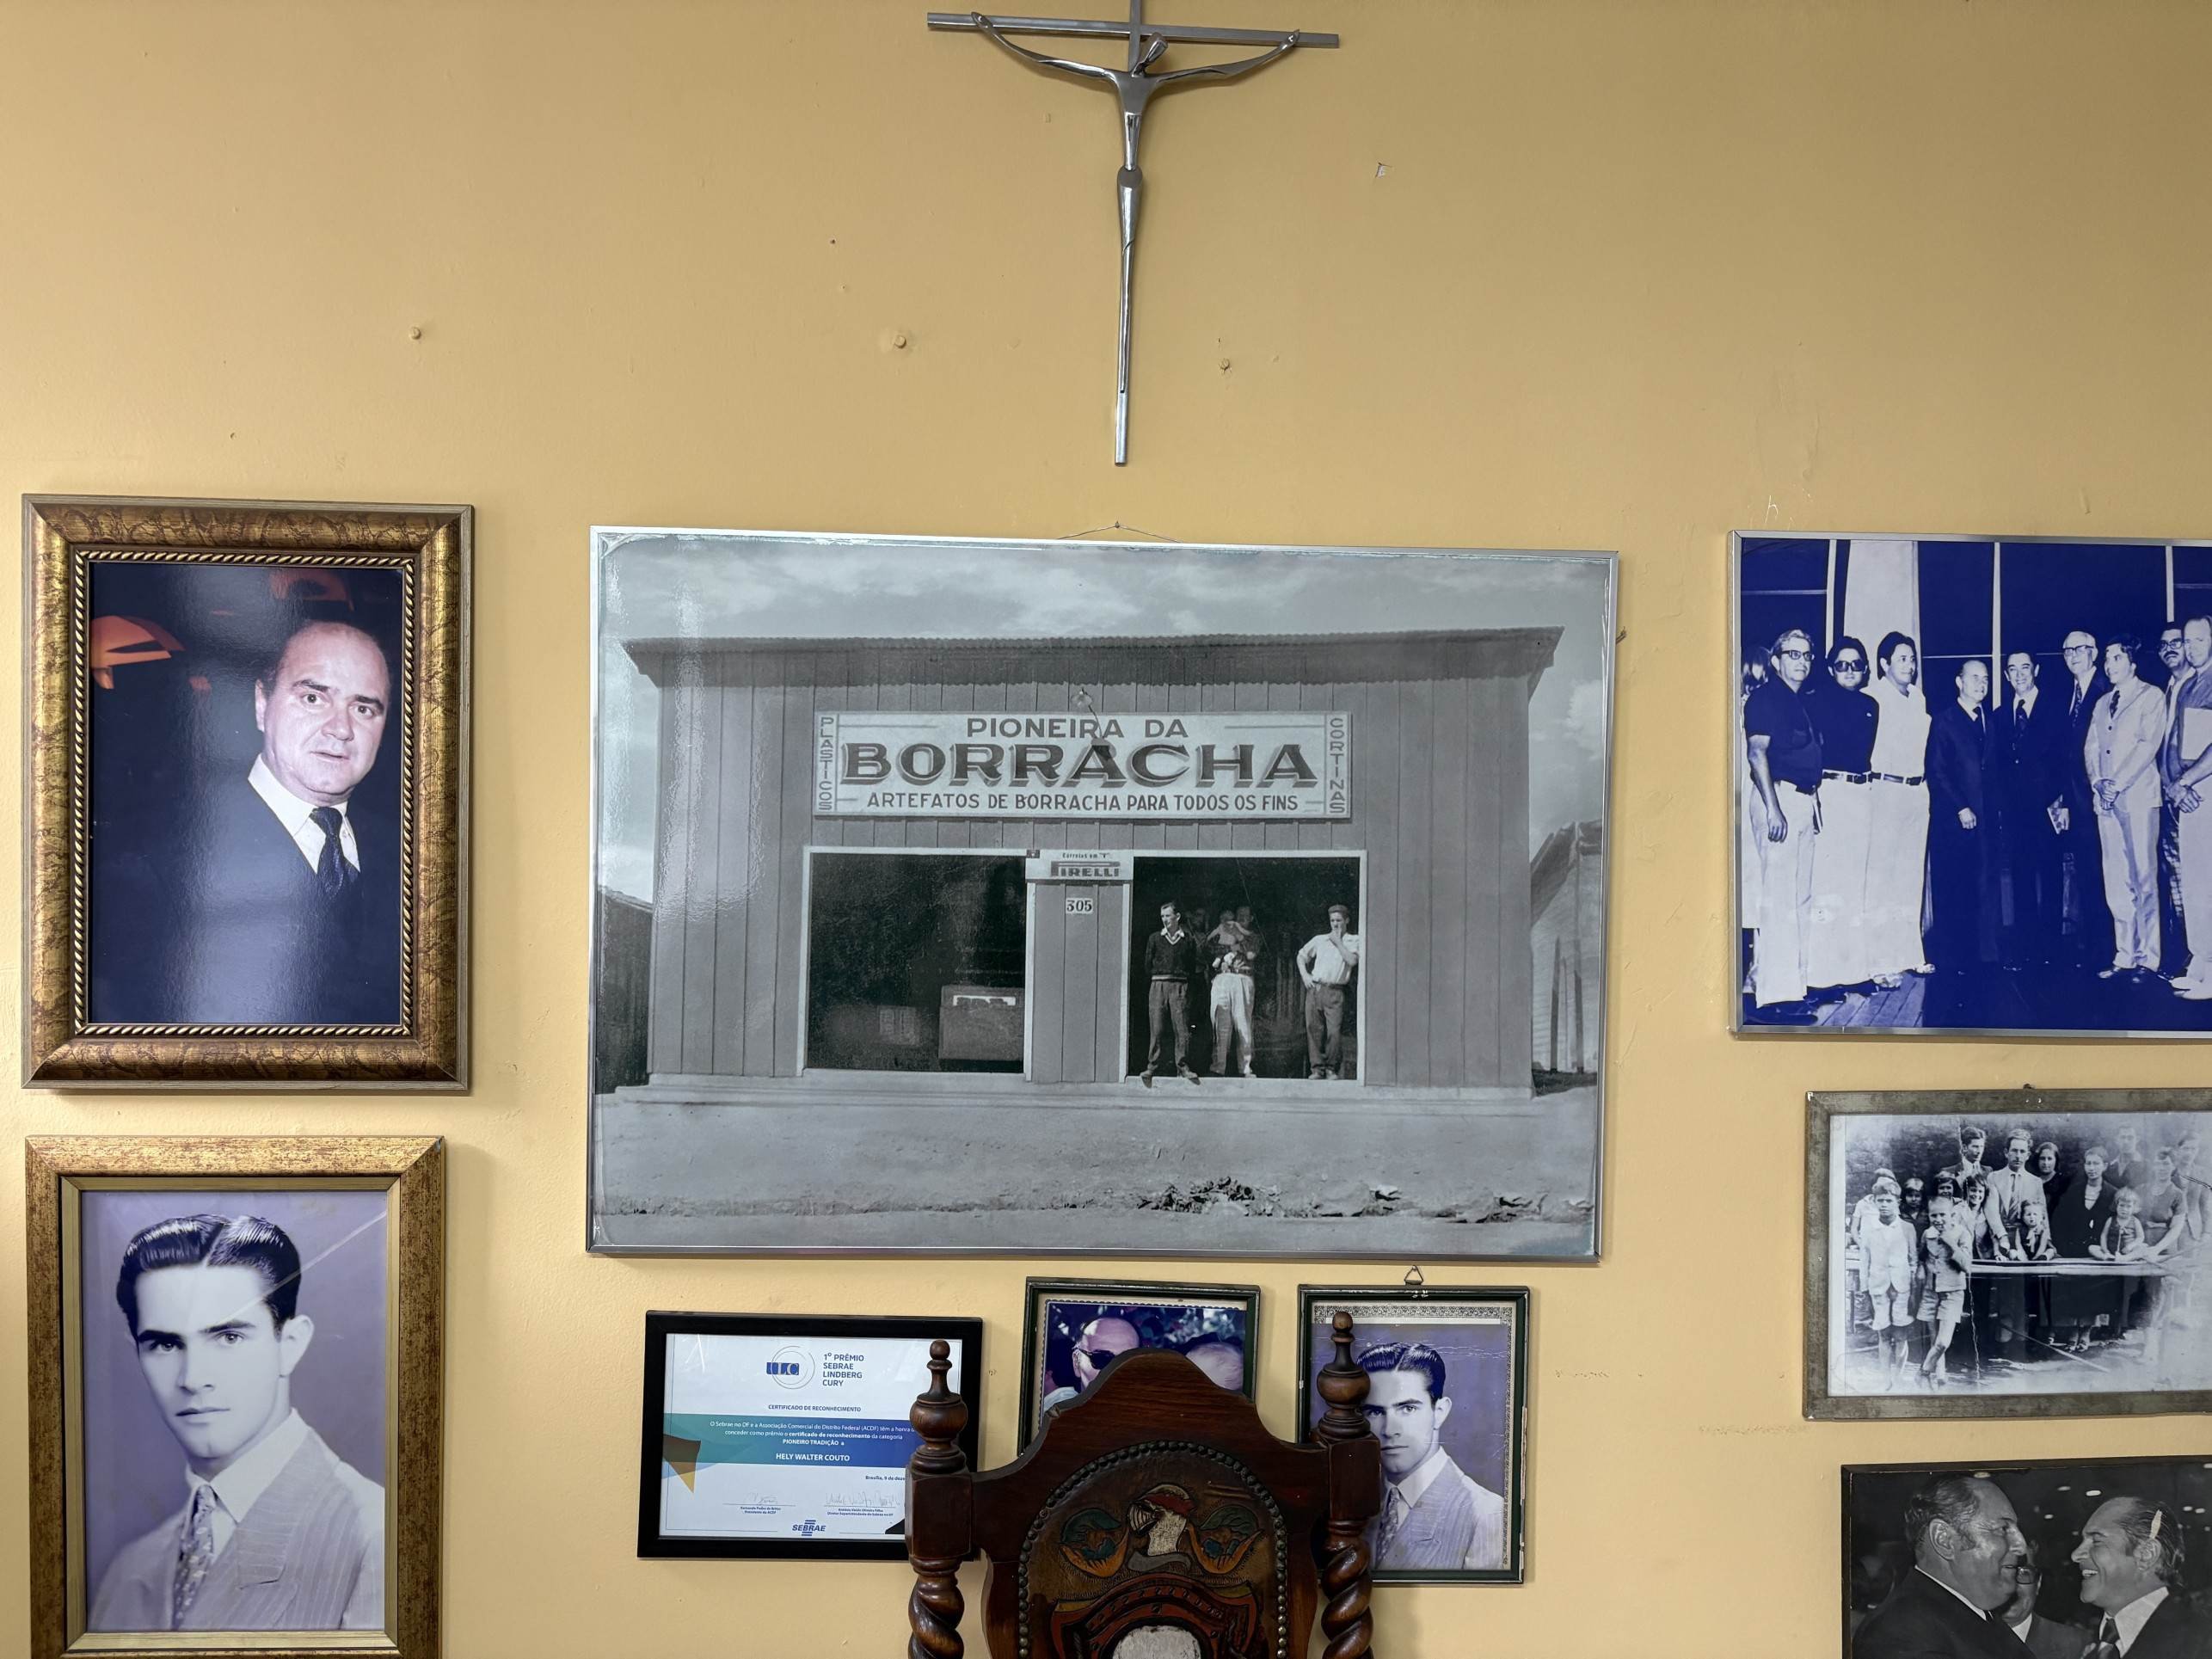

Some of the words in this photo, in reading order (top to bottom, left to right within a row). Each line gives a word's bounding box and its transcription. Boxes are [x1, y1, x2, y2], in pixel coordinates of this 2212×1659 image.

[967, 717, 1125, 738] PIONEIRA
[1145, 719, 1189, 738] DA
[818, 716, 833, 811] PLASTICOS
[839, 742, 1318, 788] BORRACHA
[1330, 718, 1345, 814] CORTINAS
[867, 791, 980, 809] ARTEFATOS
[989, 793, 1008, 809] DE
[1015, 793, 1121, 811] BORRACHA
[1127, 795, 1169, 811] PARA
[1174, 795, 1229, 811] TODOS
[1235, 795, 1257, 811] OS
[1263, 795, 1298, 811] FINS
[1051, 861, 1121, 877] PIRELLI
[1066, 900, 1092, 912] 305
[833, 1353, 864, 1361] PRÊMIO
